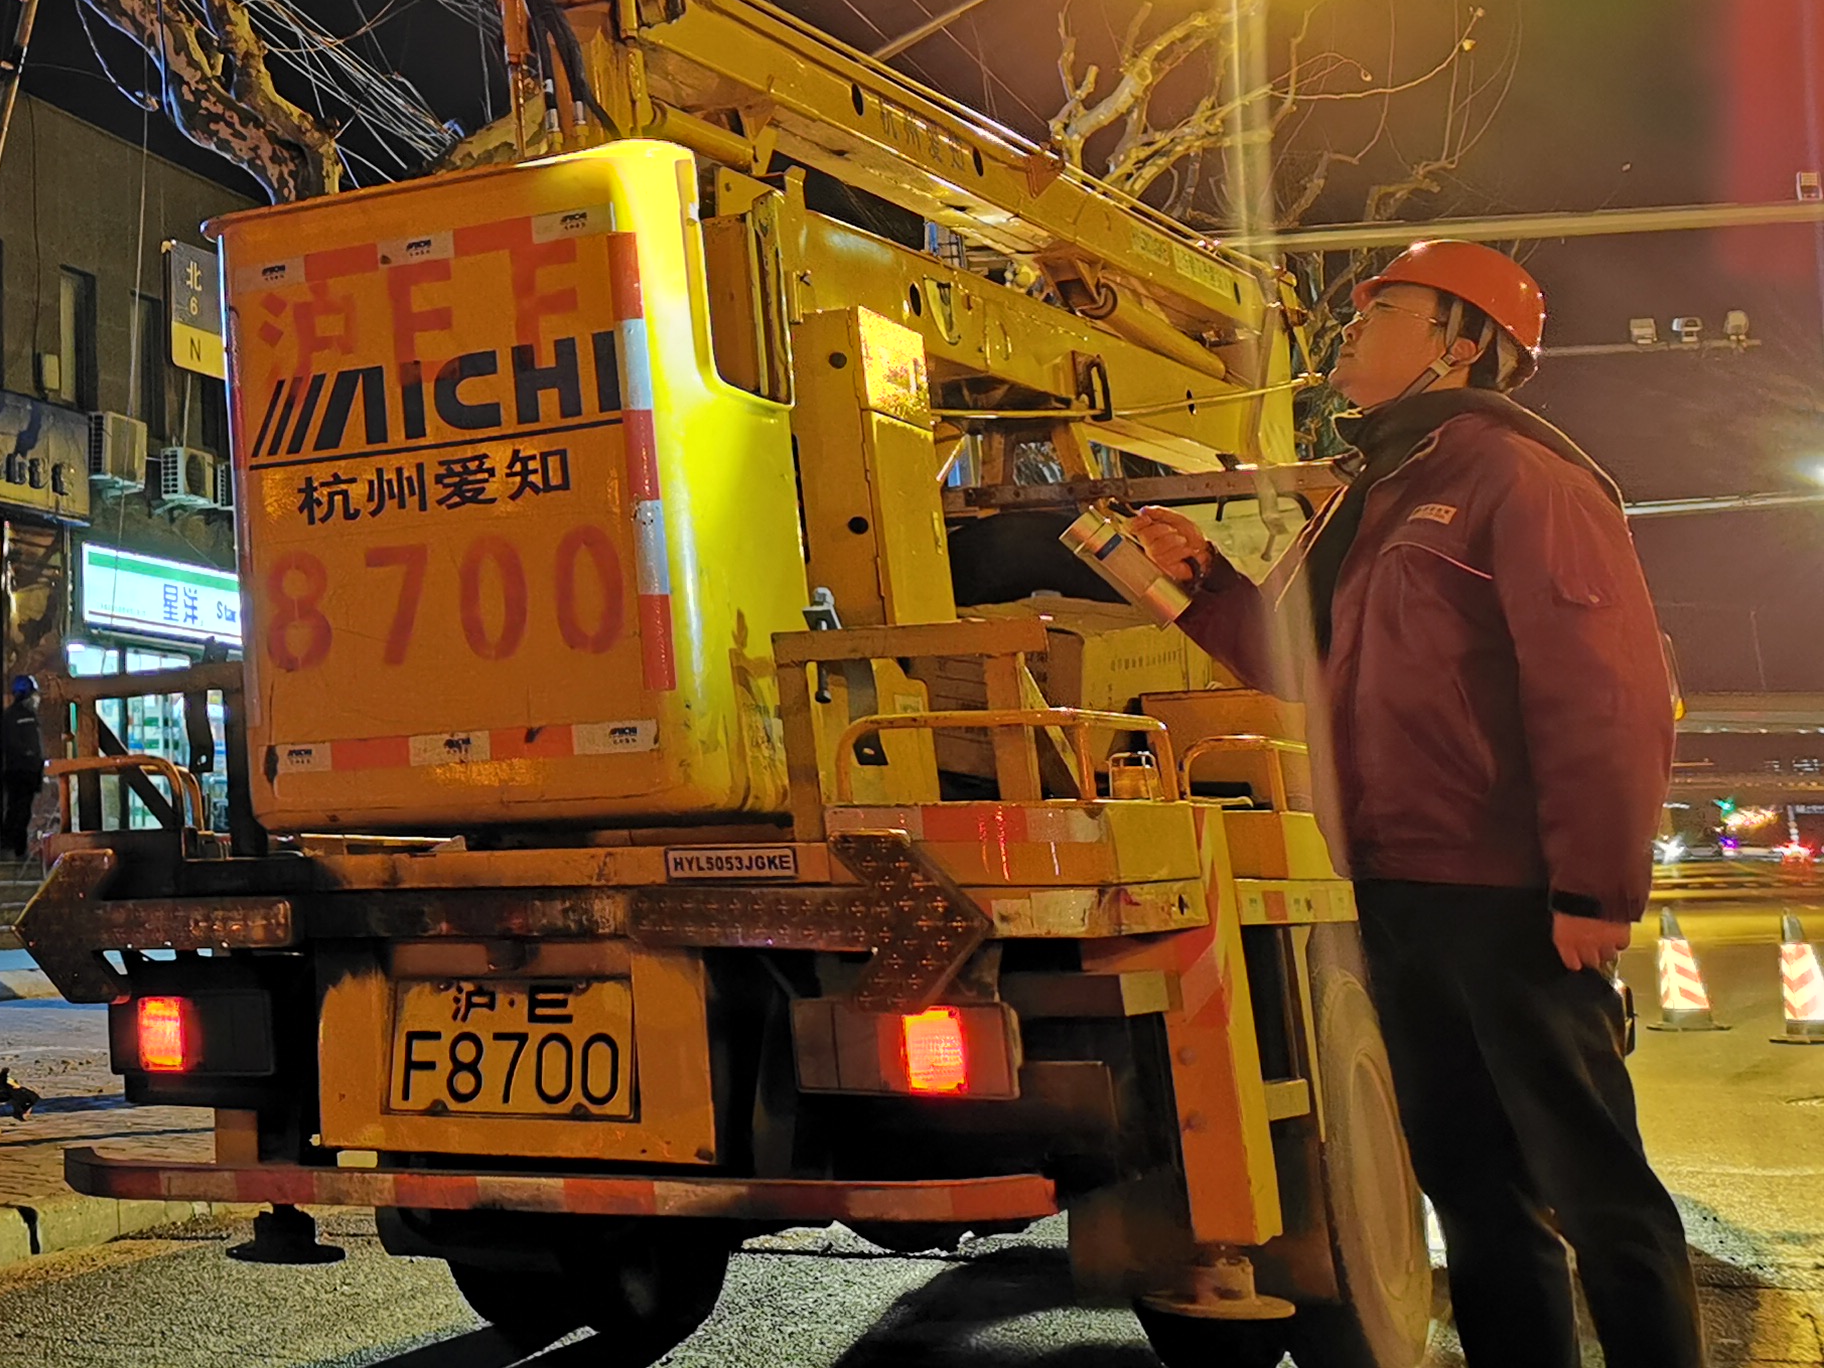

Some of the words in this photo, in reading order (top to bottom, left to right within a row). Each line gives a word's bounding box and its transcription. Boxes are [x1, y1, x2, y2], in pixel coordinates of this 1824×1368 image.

[186, 260, 203, 291] 北
[190, 336, 201, 362] N
[252, 330, 622, 458] AICHI
[297, 448, 572, 526] 杭州爱知
[267, 524, 625, 672] 8700
[673, 853, 793, 874] HYL5053JGKE
[401, 1030, 620, 1106] F8700
